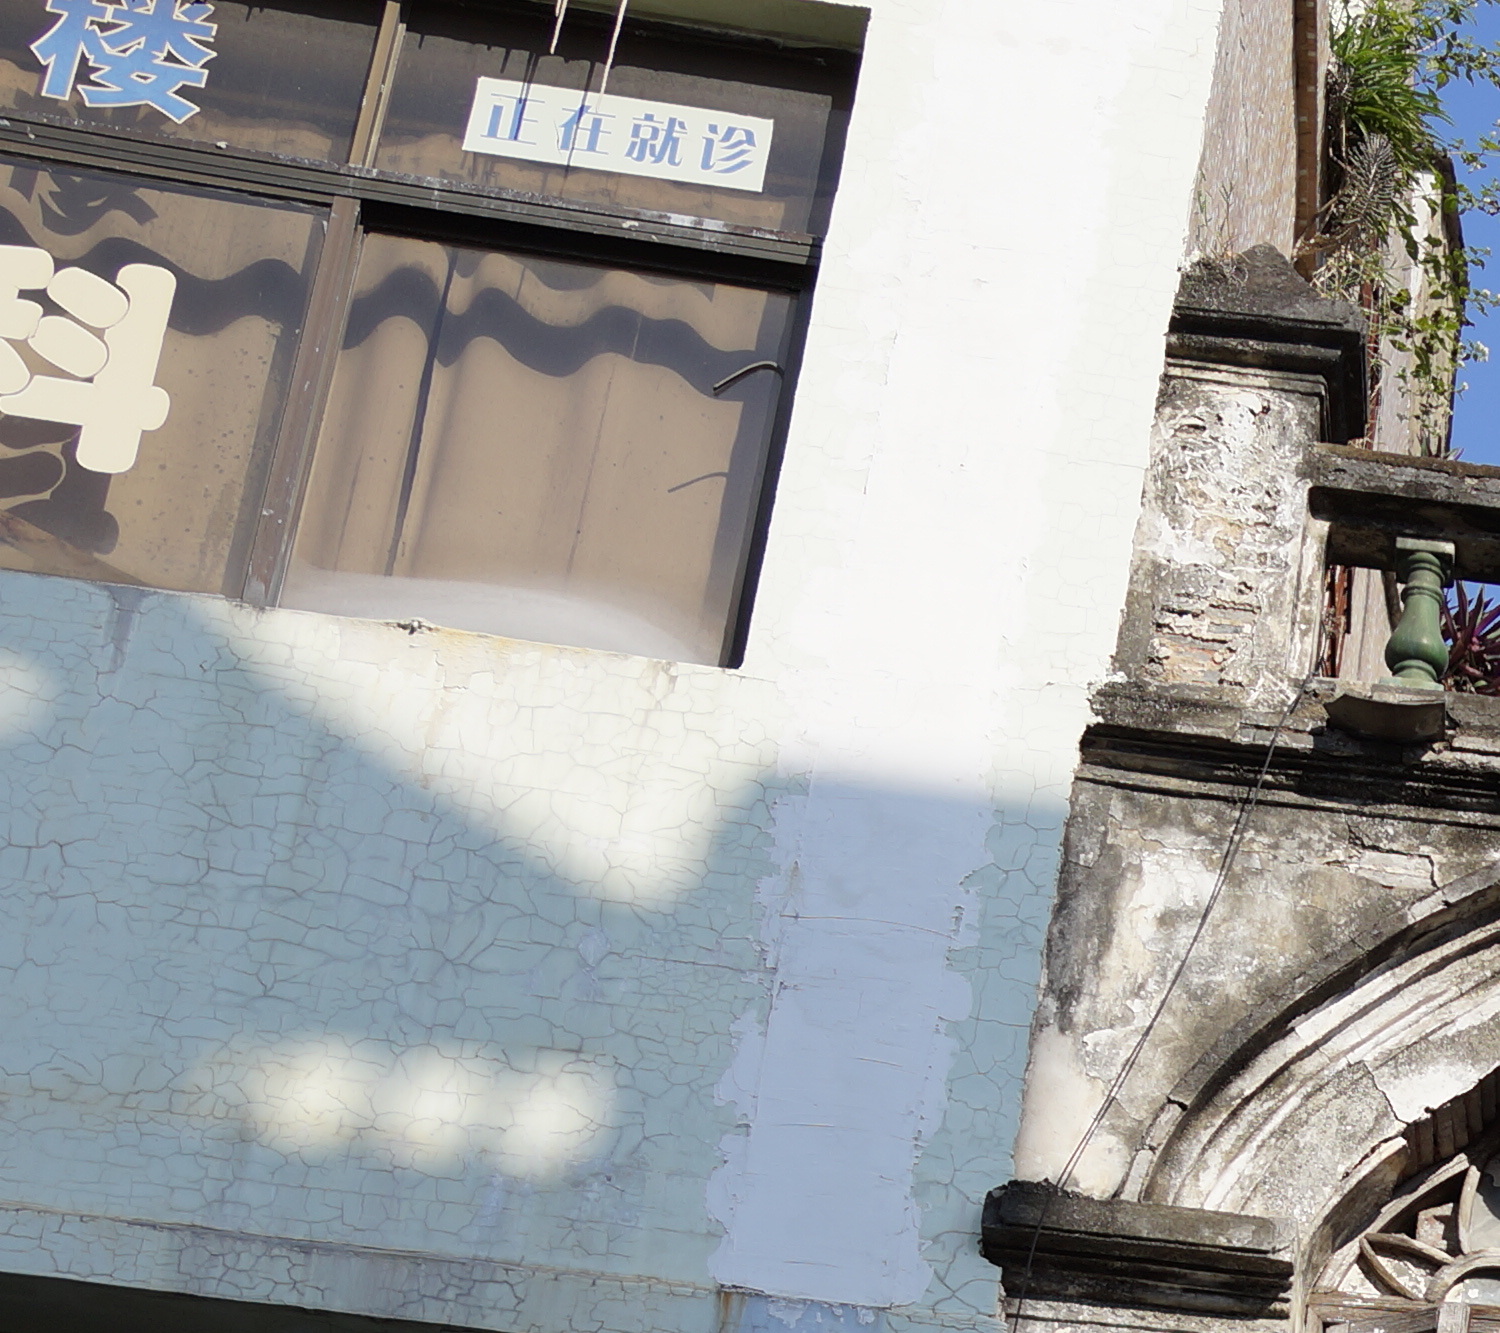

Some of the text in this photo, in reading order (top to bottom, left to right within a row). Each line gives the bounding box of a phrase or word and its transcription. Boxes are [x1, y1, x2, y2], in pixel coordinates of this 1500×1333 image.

[31, 0, 217, 124] 楼
[480, 92, 757, 175] 正在就诊
